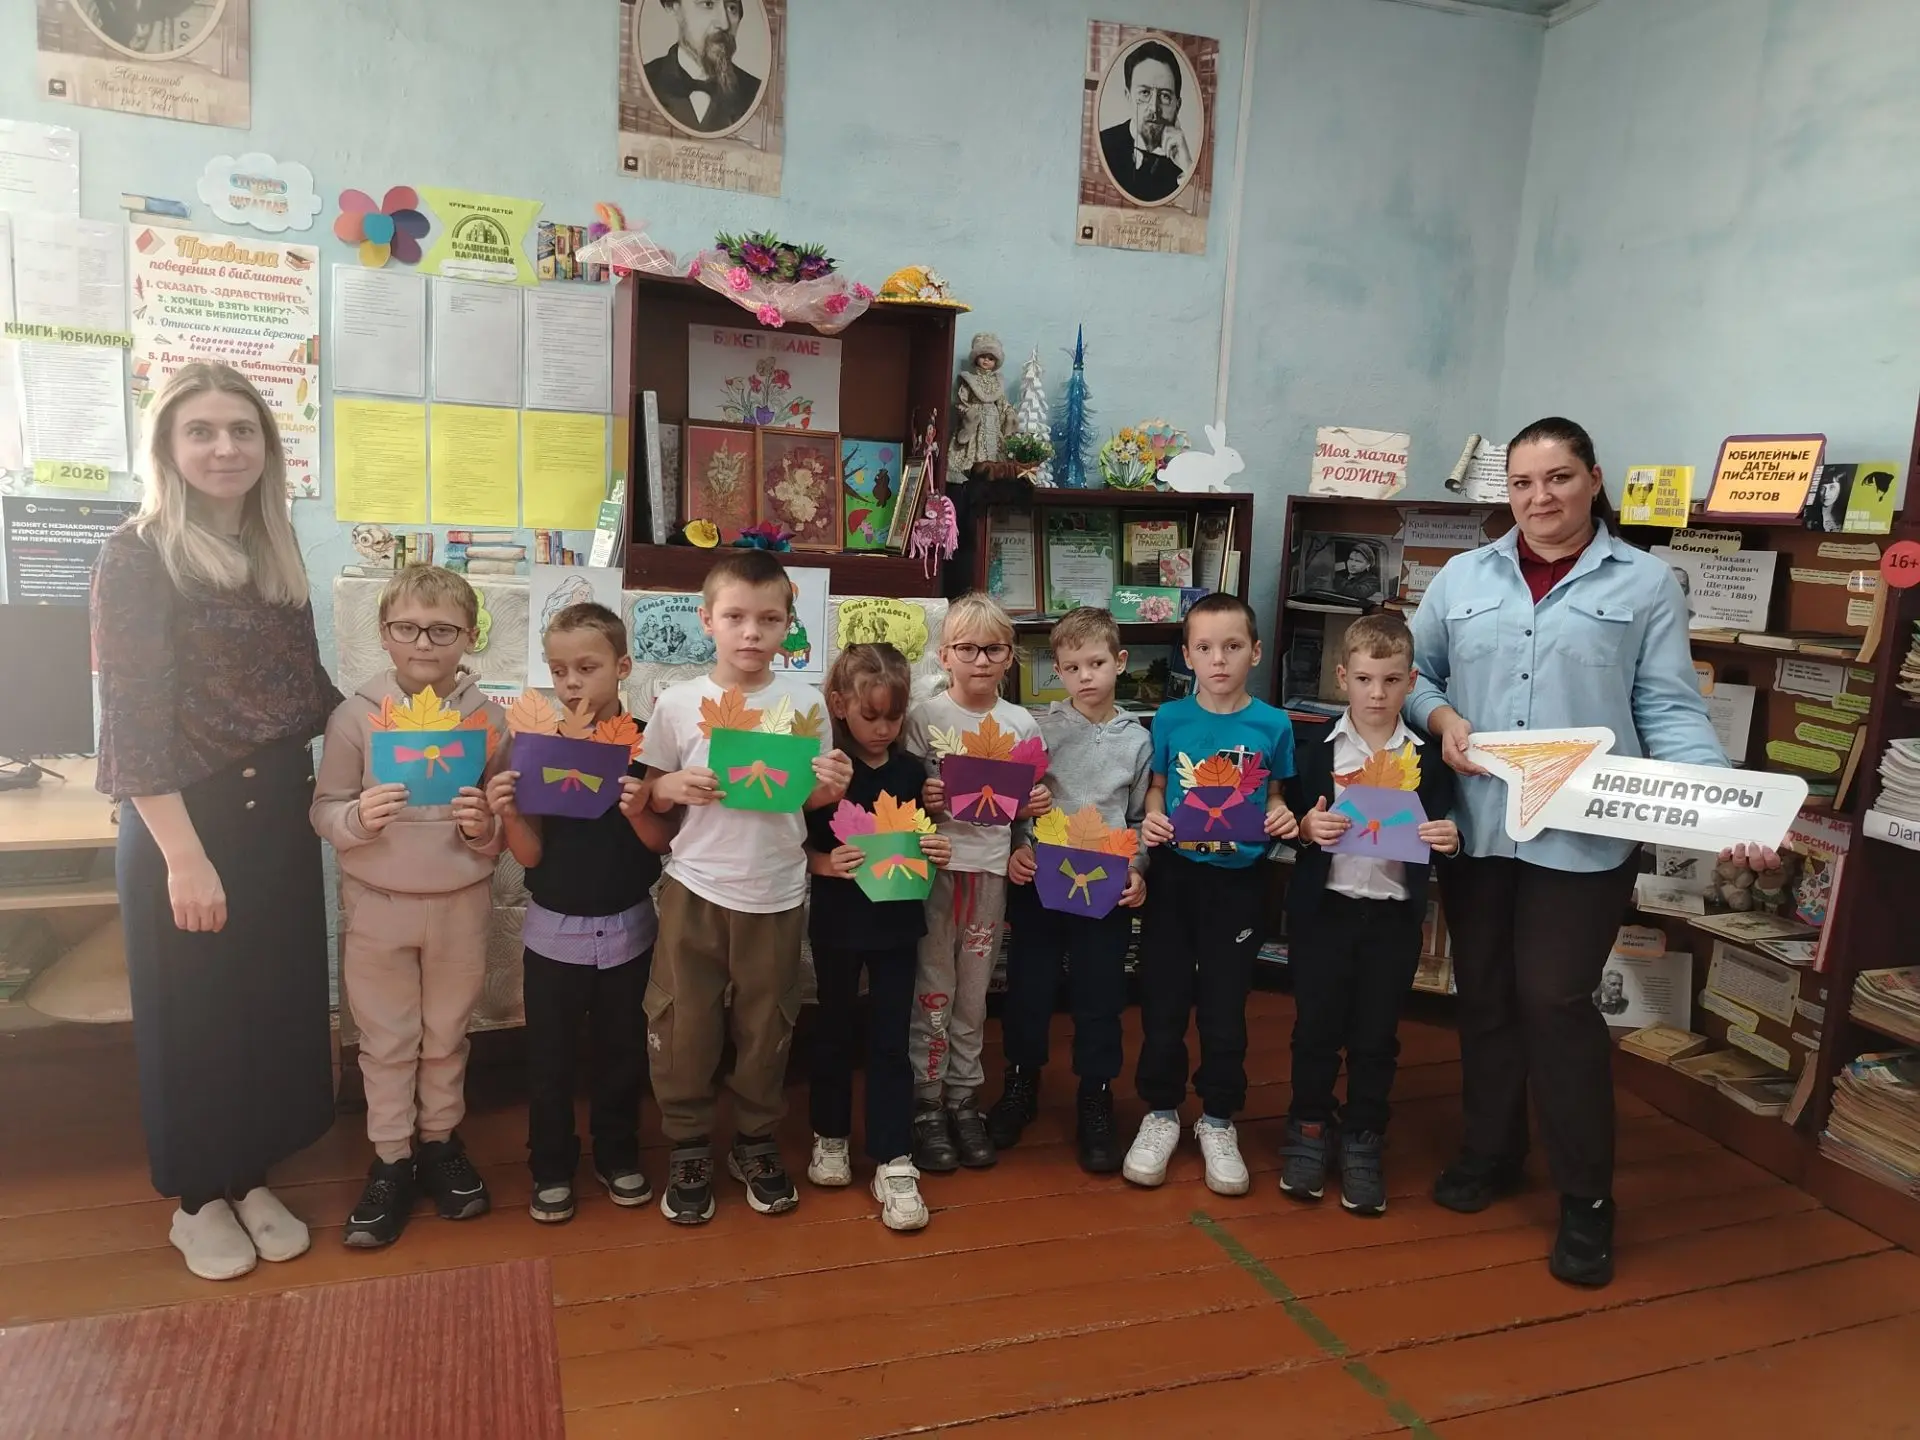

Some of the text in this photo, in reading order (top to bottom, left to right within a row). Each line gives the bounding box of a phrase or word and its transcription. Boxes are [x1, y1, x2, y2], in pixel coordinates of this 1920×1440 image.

[174, 235, 279, 268] Правила
[149, 260, 304, 286] поведения в библиотеке
[156, 280, 207, 294] СКАЗАТЬ
[170, 295, 215, 308] ХОЧЕШЬ
[218, 301, 250, 312] ВЗЯТЬ
[164, 305, 289, 325] СКАЖИ БИБЛИОТЕКАРЮ
[160, 317, 211, 332] Относись
[212, 324, 220, 332] к
[222, 325, 261, 336] книгам
[263, 328, 306, 342] бережно
[161, 352, 185, 364] Для
[241, 358, 306, 376] библиотеку
[1315, 443, 1408, 465] Моя малая
[1728, 450, 1811, 461] ЮБИЛЕЙНЫЕ
[60, 465, 105, 481] 2026
[1743, 461, 1780, 472] ДАТЫ
[1322, 466, 1397, 487] РОДИНА
[1721, 469, 1809, 481] ПИСАТЕЛЕЙ И
[1729, 490, 1780, 501] ПОЭТОВ
[48, 523, 105, 531] НЕЗНАКОМОГО
[1408, 520, 1430, 530] Край
[1674, 529, 1741, 541] 200-летний
[1671, 544, 1720, 554] юбилей
[1714, 555, 1751, 564] Михаил
[1889, 553, 1920, 569] 16+
[1700, 562, 1759, 573] Евграфович
[1703, 572, 1756, 582] Салтыков-
[1706, 581, 1745, 591] Щедрин
[1694, 589, 1720, 597] (1826
[1731, 592, 1757, 601] 1889)
[1592, 773, 1763, 808] НАВИГАТОРЫ
[1584, 798, 1699, 827] ДЕТСТВА
[1888, 821, 1920, 843] Dian
